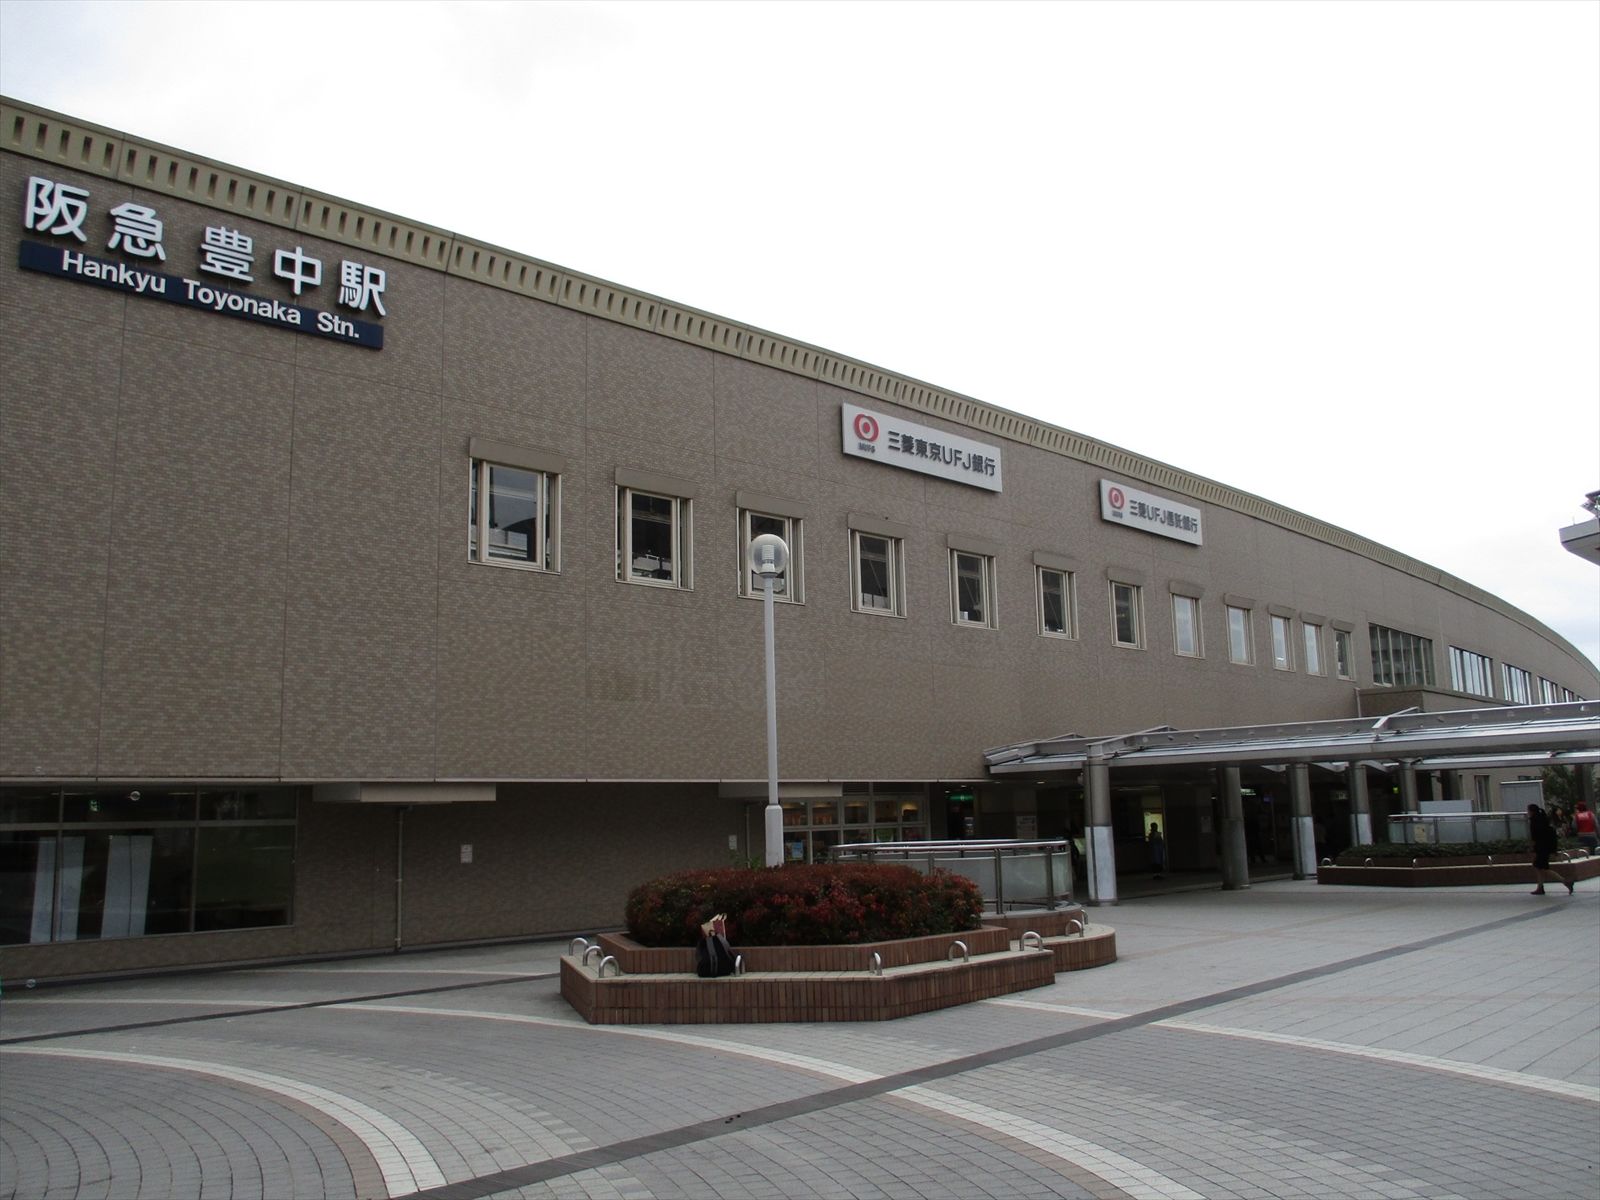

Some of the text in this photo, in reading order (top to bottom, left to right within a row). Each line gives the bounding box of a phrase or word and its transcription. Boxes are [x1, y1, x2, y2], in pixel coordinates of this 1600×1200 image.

[25, 176, 387, 316] 阪急豊中駅
[62, 250, 360, 338] Hankyu Toyonaka Stn.
[888, 430, 996, 477] 三菱東京UFJ銀行
